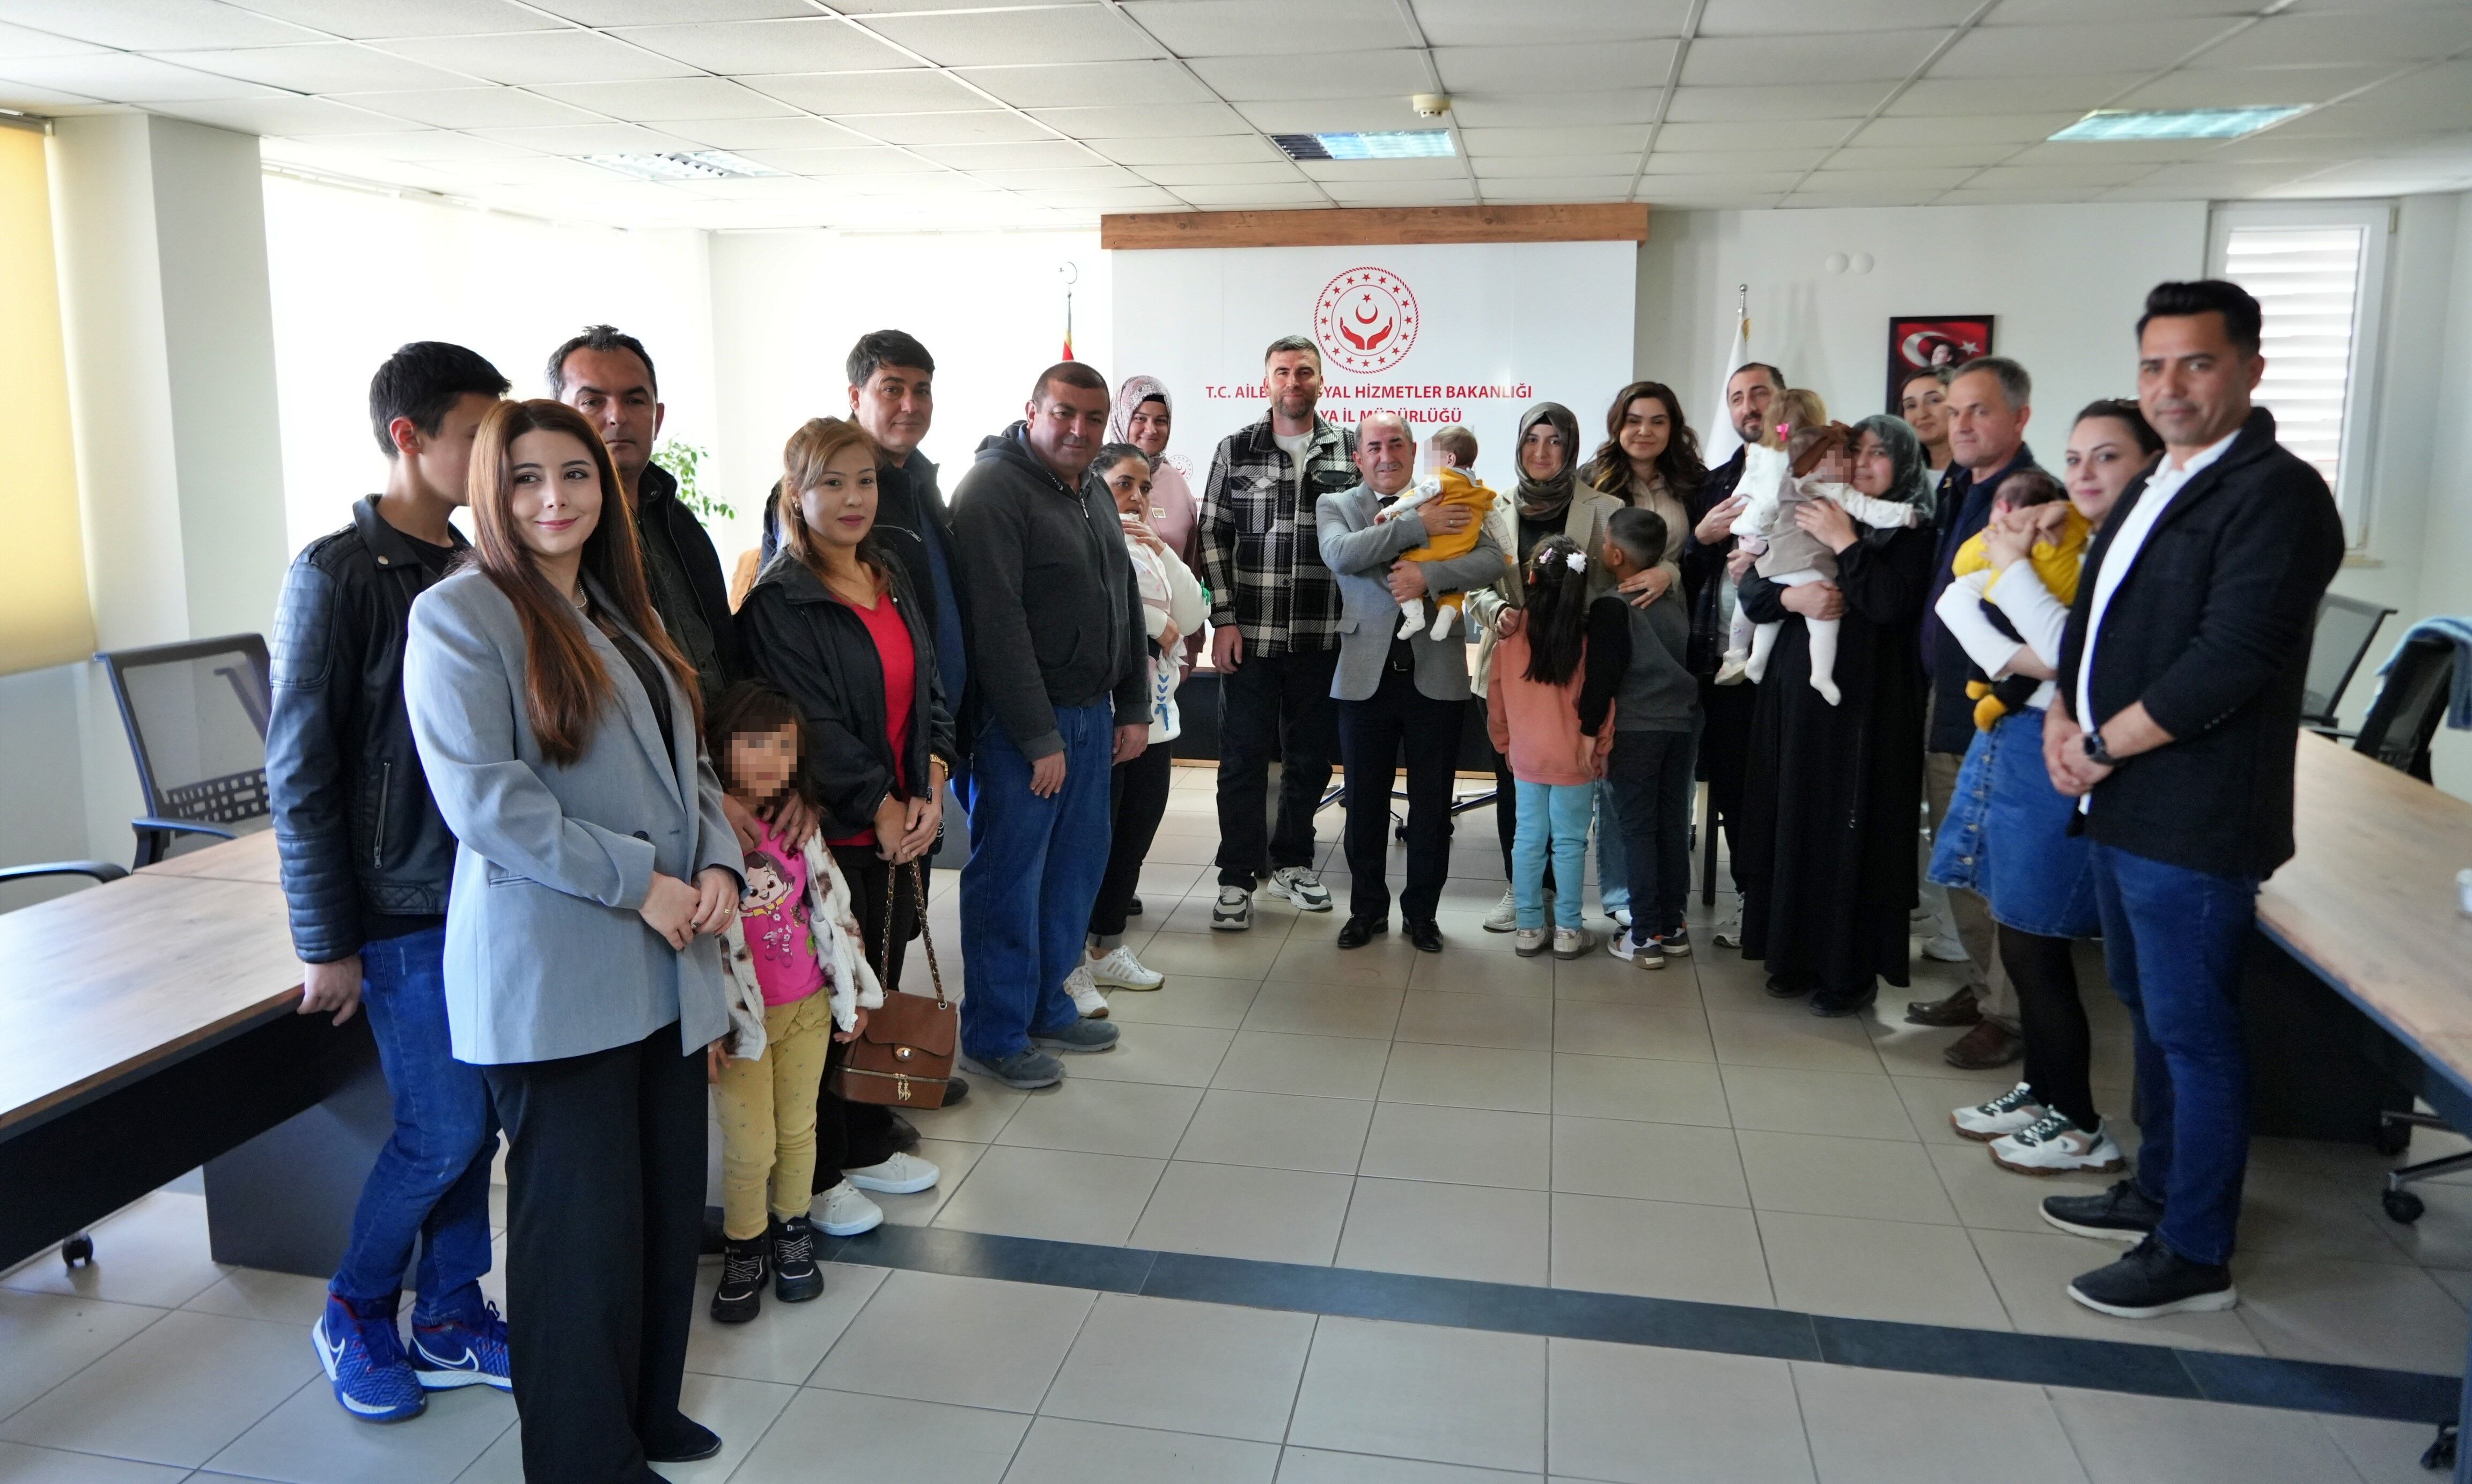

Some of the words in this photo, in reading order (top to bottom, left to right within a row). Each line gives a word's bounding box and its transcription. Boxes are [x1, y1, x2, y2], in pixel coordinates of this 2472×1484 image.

[1205, 386, 1231, 398] T.C.
[1235, 383, 1267, 398] AİLE
[1318, 386, 1351, 398] YAL
[1355, 383, 1443, 398] HİZMETLER
[1446, 383, 1533, 398] BAKANLIĞI
[1320, 410, 1338, 422] YA
[1343, 407, 1356, 422] İL
